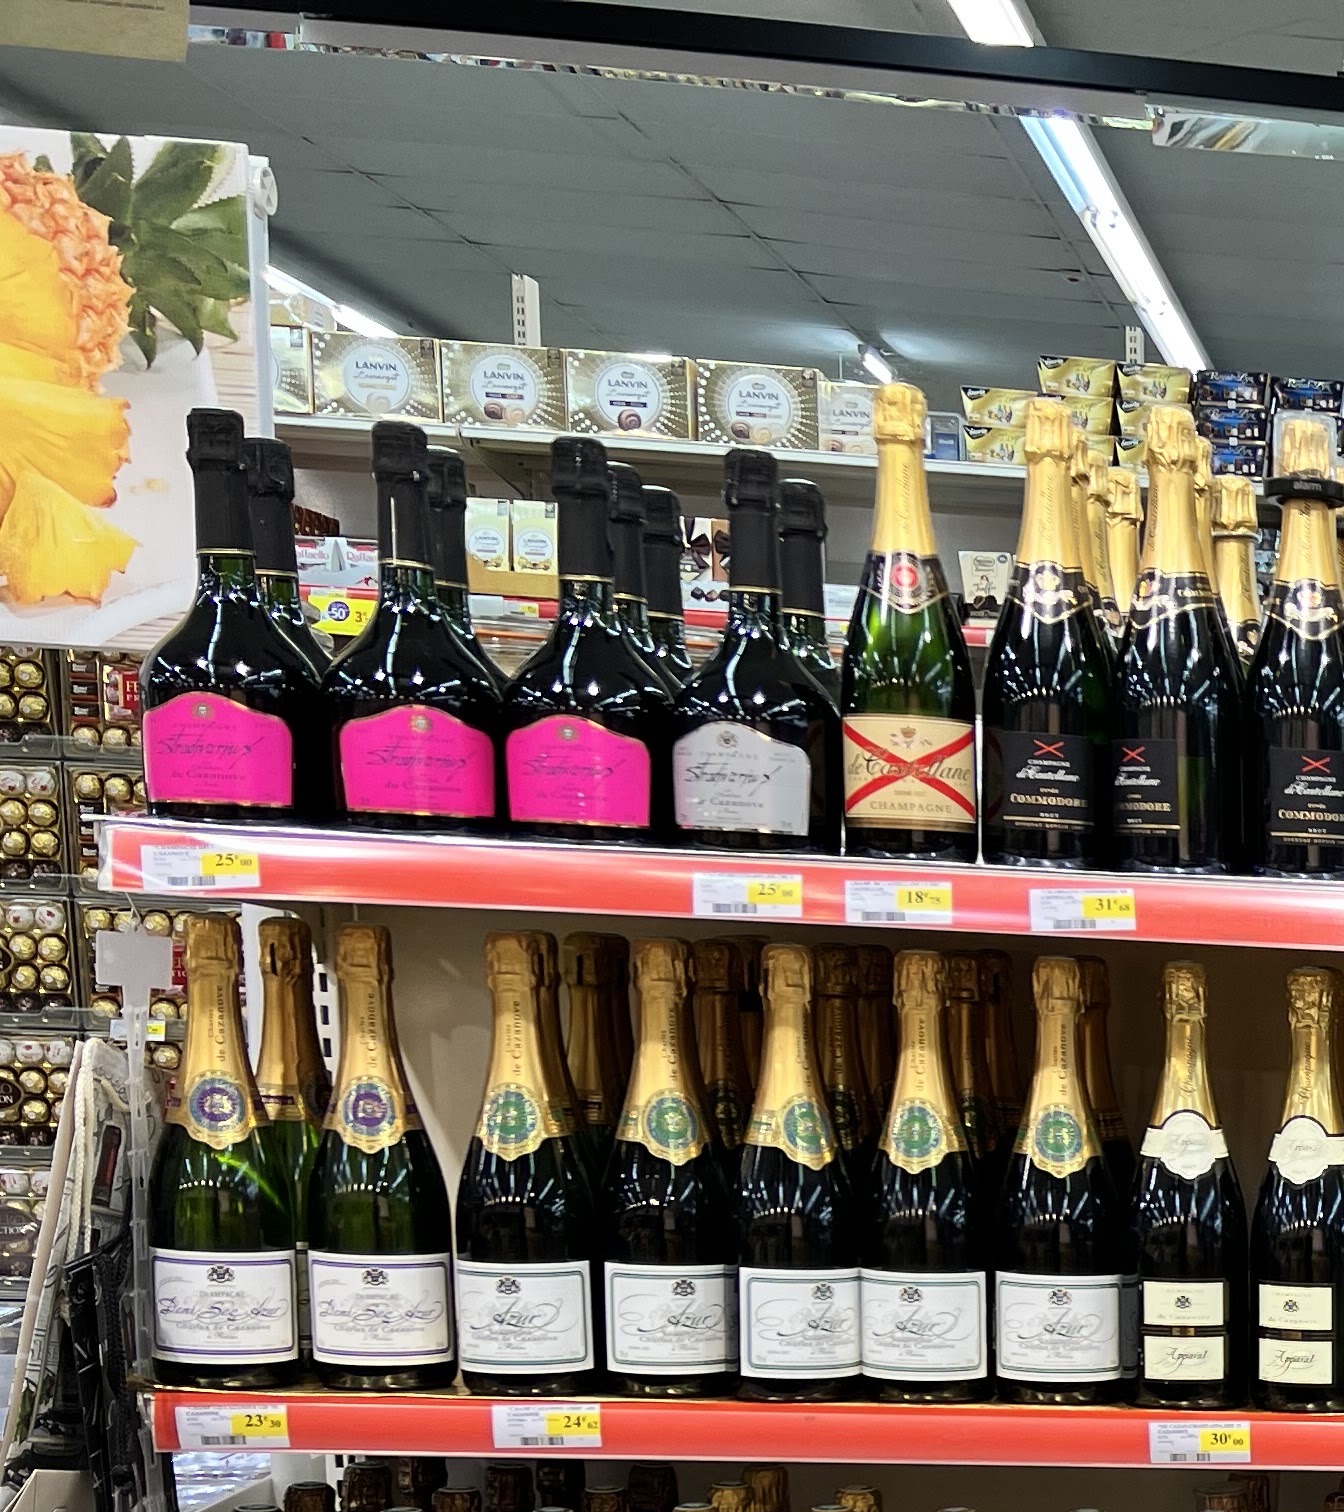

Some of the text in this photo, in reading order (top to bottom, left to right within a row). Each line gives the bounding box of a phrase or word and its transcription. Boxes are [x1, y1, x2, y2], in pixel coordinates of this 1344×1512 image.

[355, 361, 397, 373] LANVIN
[483, 370, 525, 381] LANVIN
[607, 379, 648, 390] LANVIN
[870, 801, 952, 814] CHAMPAGNE
[1010, 794, 1088, 809] COMMODORE
